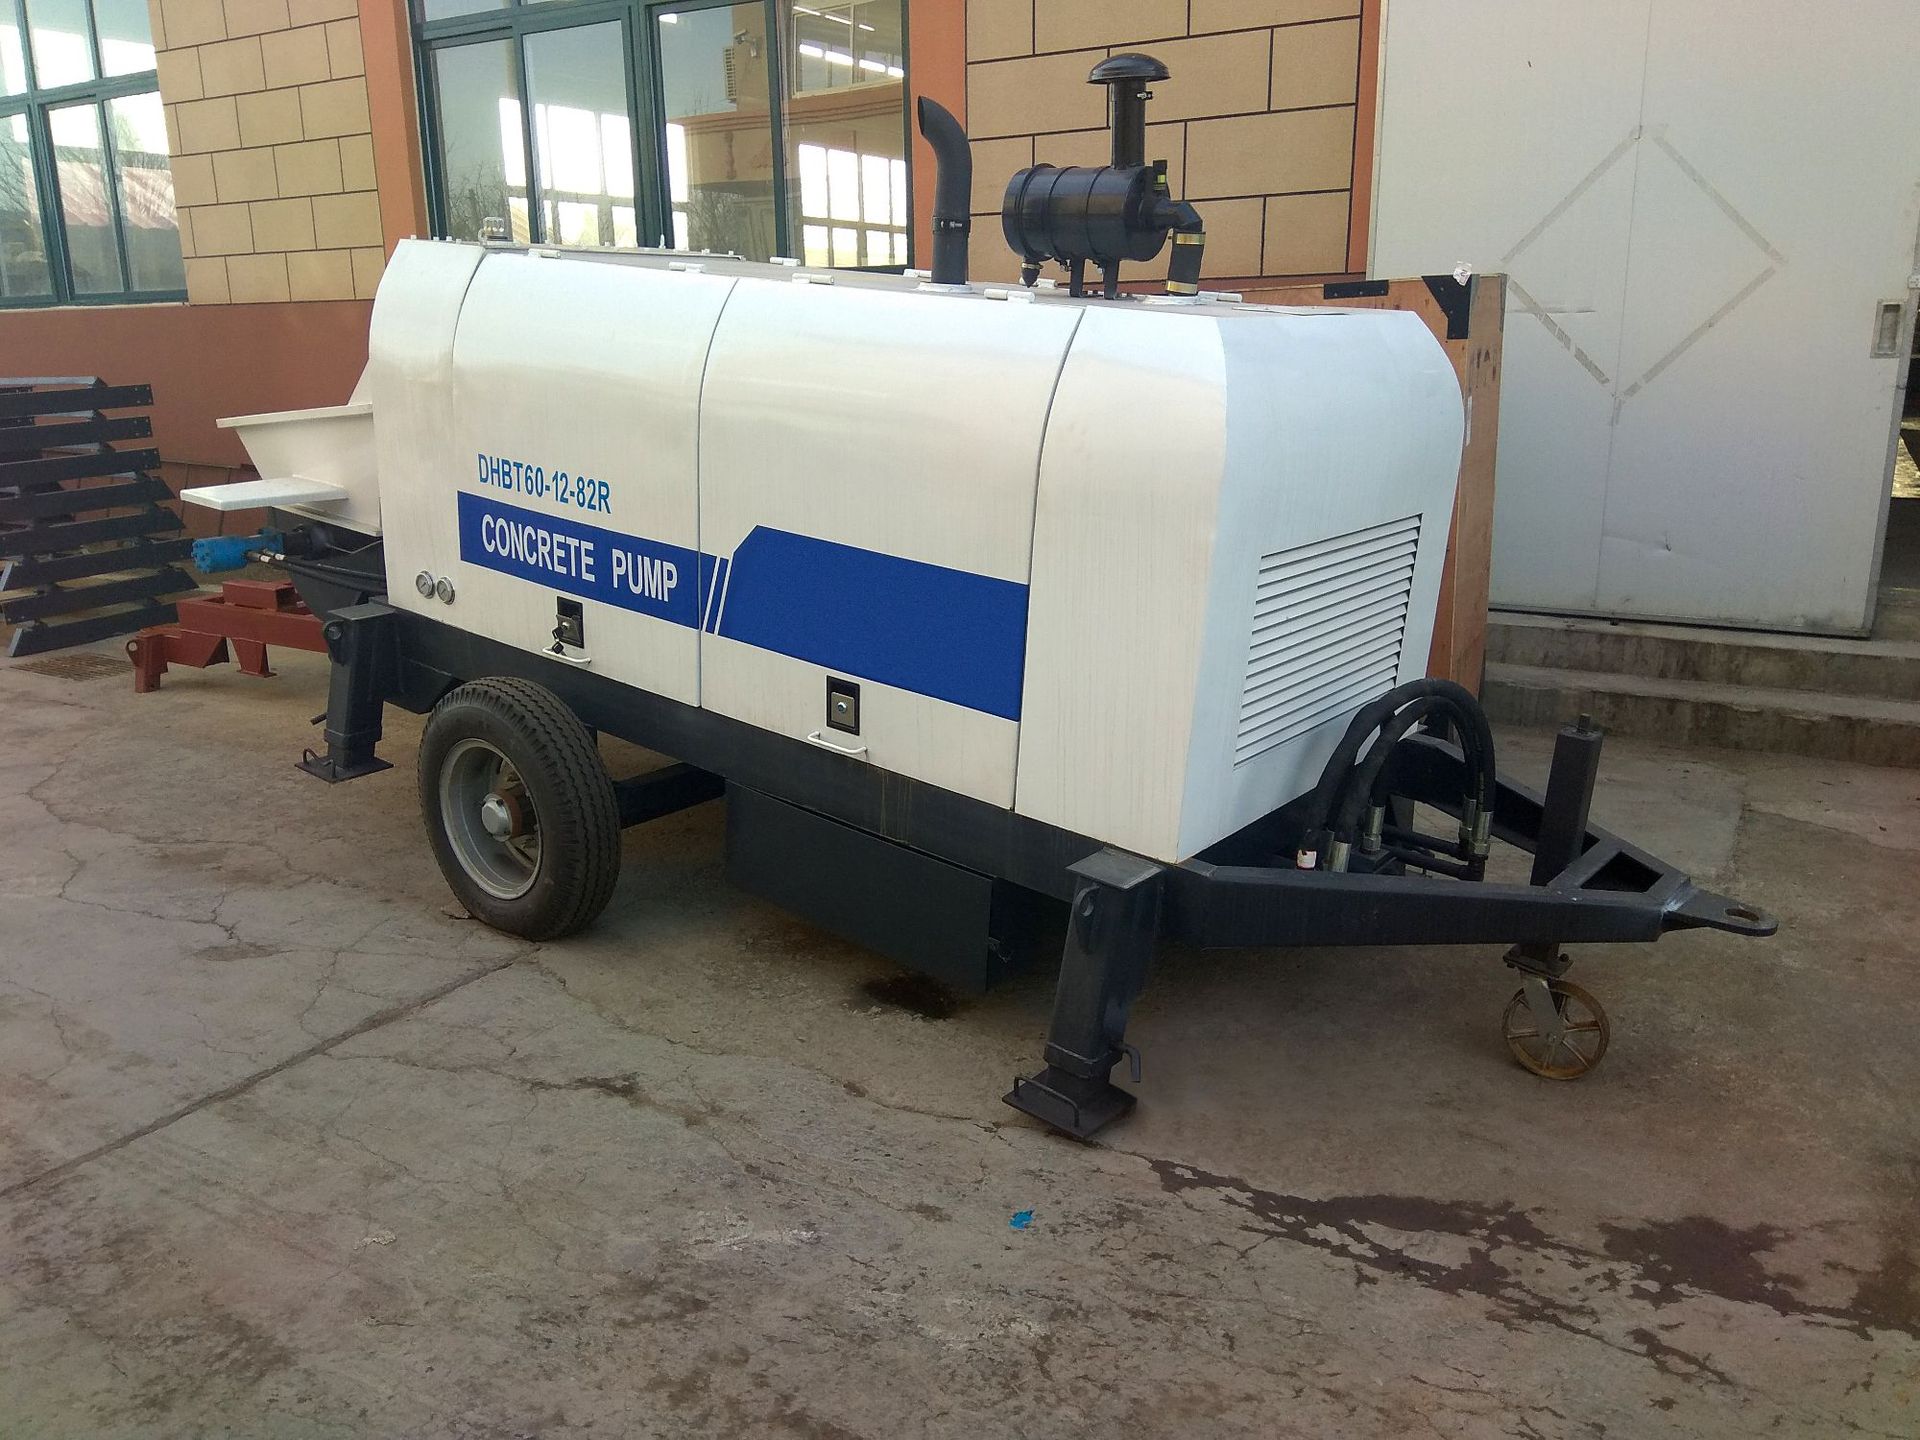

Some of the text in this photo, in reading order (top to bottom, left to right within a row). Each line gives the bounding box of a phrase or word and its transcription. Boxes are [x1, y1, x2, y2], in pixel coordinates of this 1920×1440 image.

[477, 453, 611, 514] DHBT60-12-82R
[481, 514, 678, 602] CONCRETE PUMP
